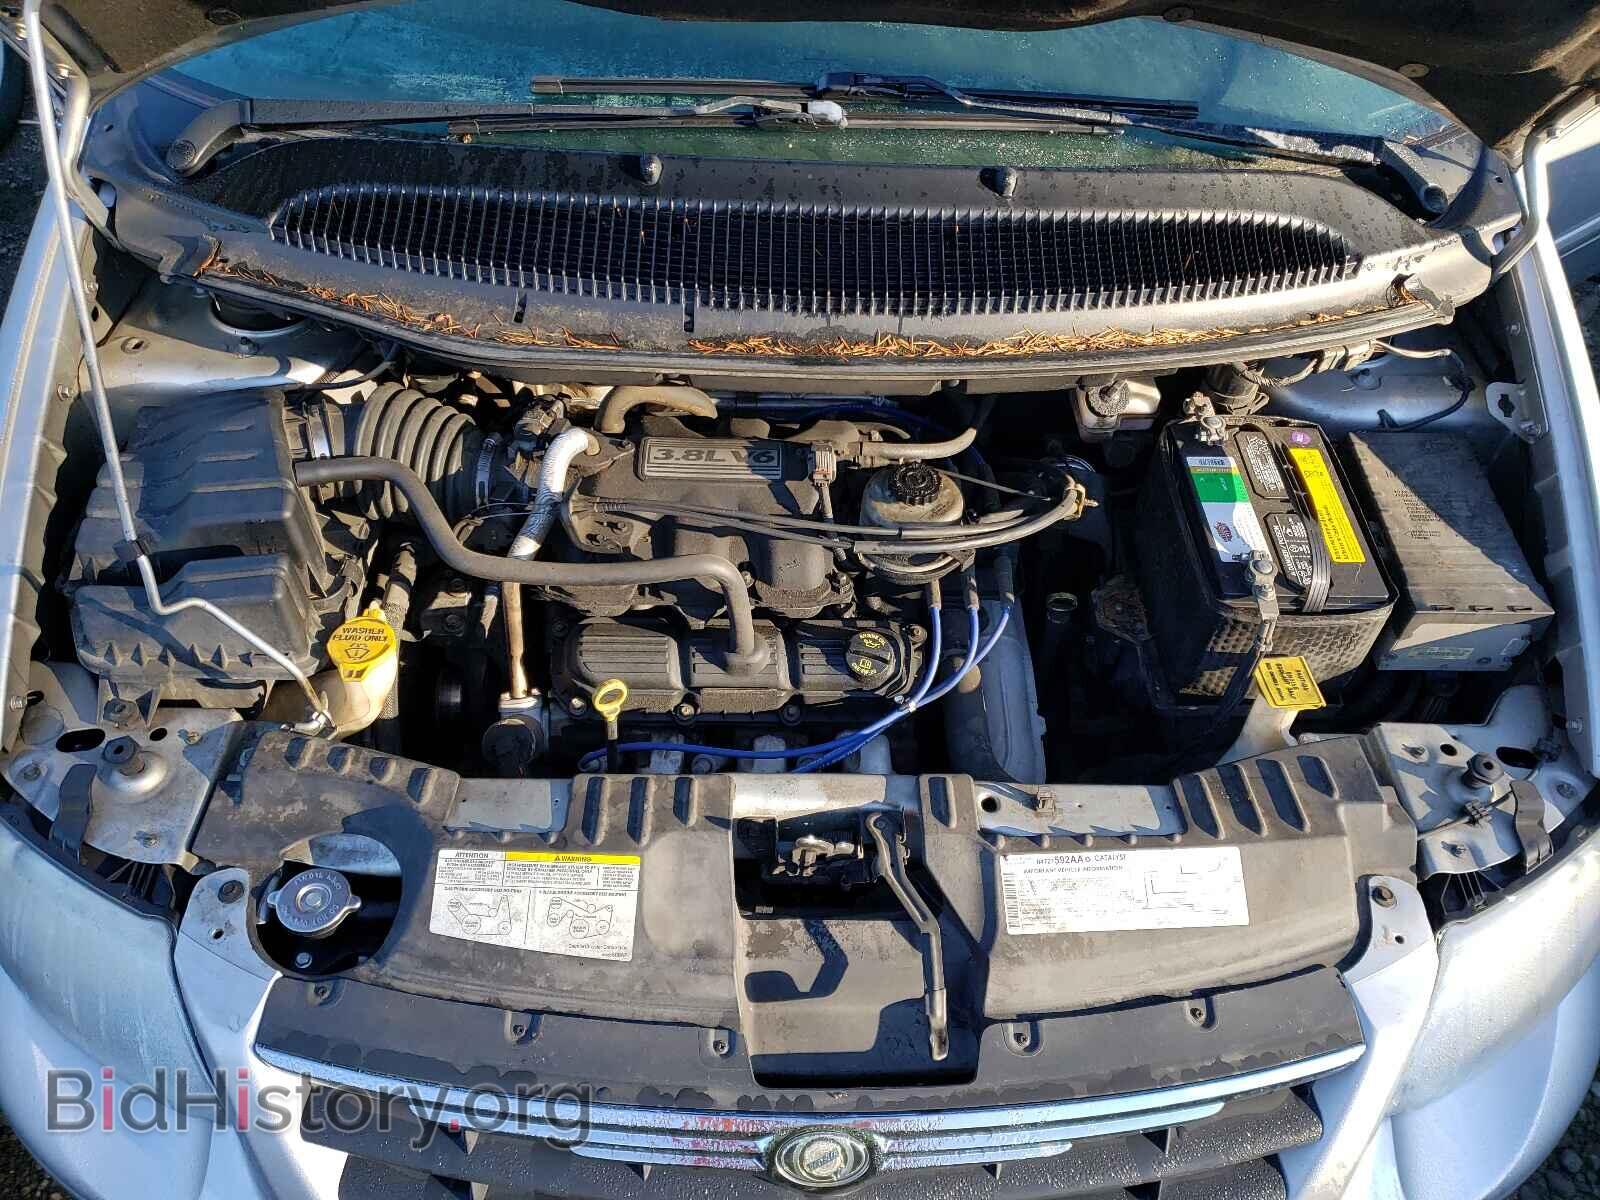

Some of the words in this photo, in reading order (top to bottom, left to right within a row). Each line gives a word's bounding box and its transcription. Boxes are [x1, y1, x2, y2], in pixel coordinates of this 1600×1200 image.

[653, 448, 727, 462] 3.8L
[731, 450, 776, 463] V6
[342, 627, 385, 635] WASHER
[1093, 853, 1127, 862] CATALYST
